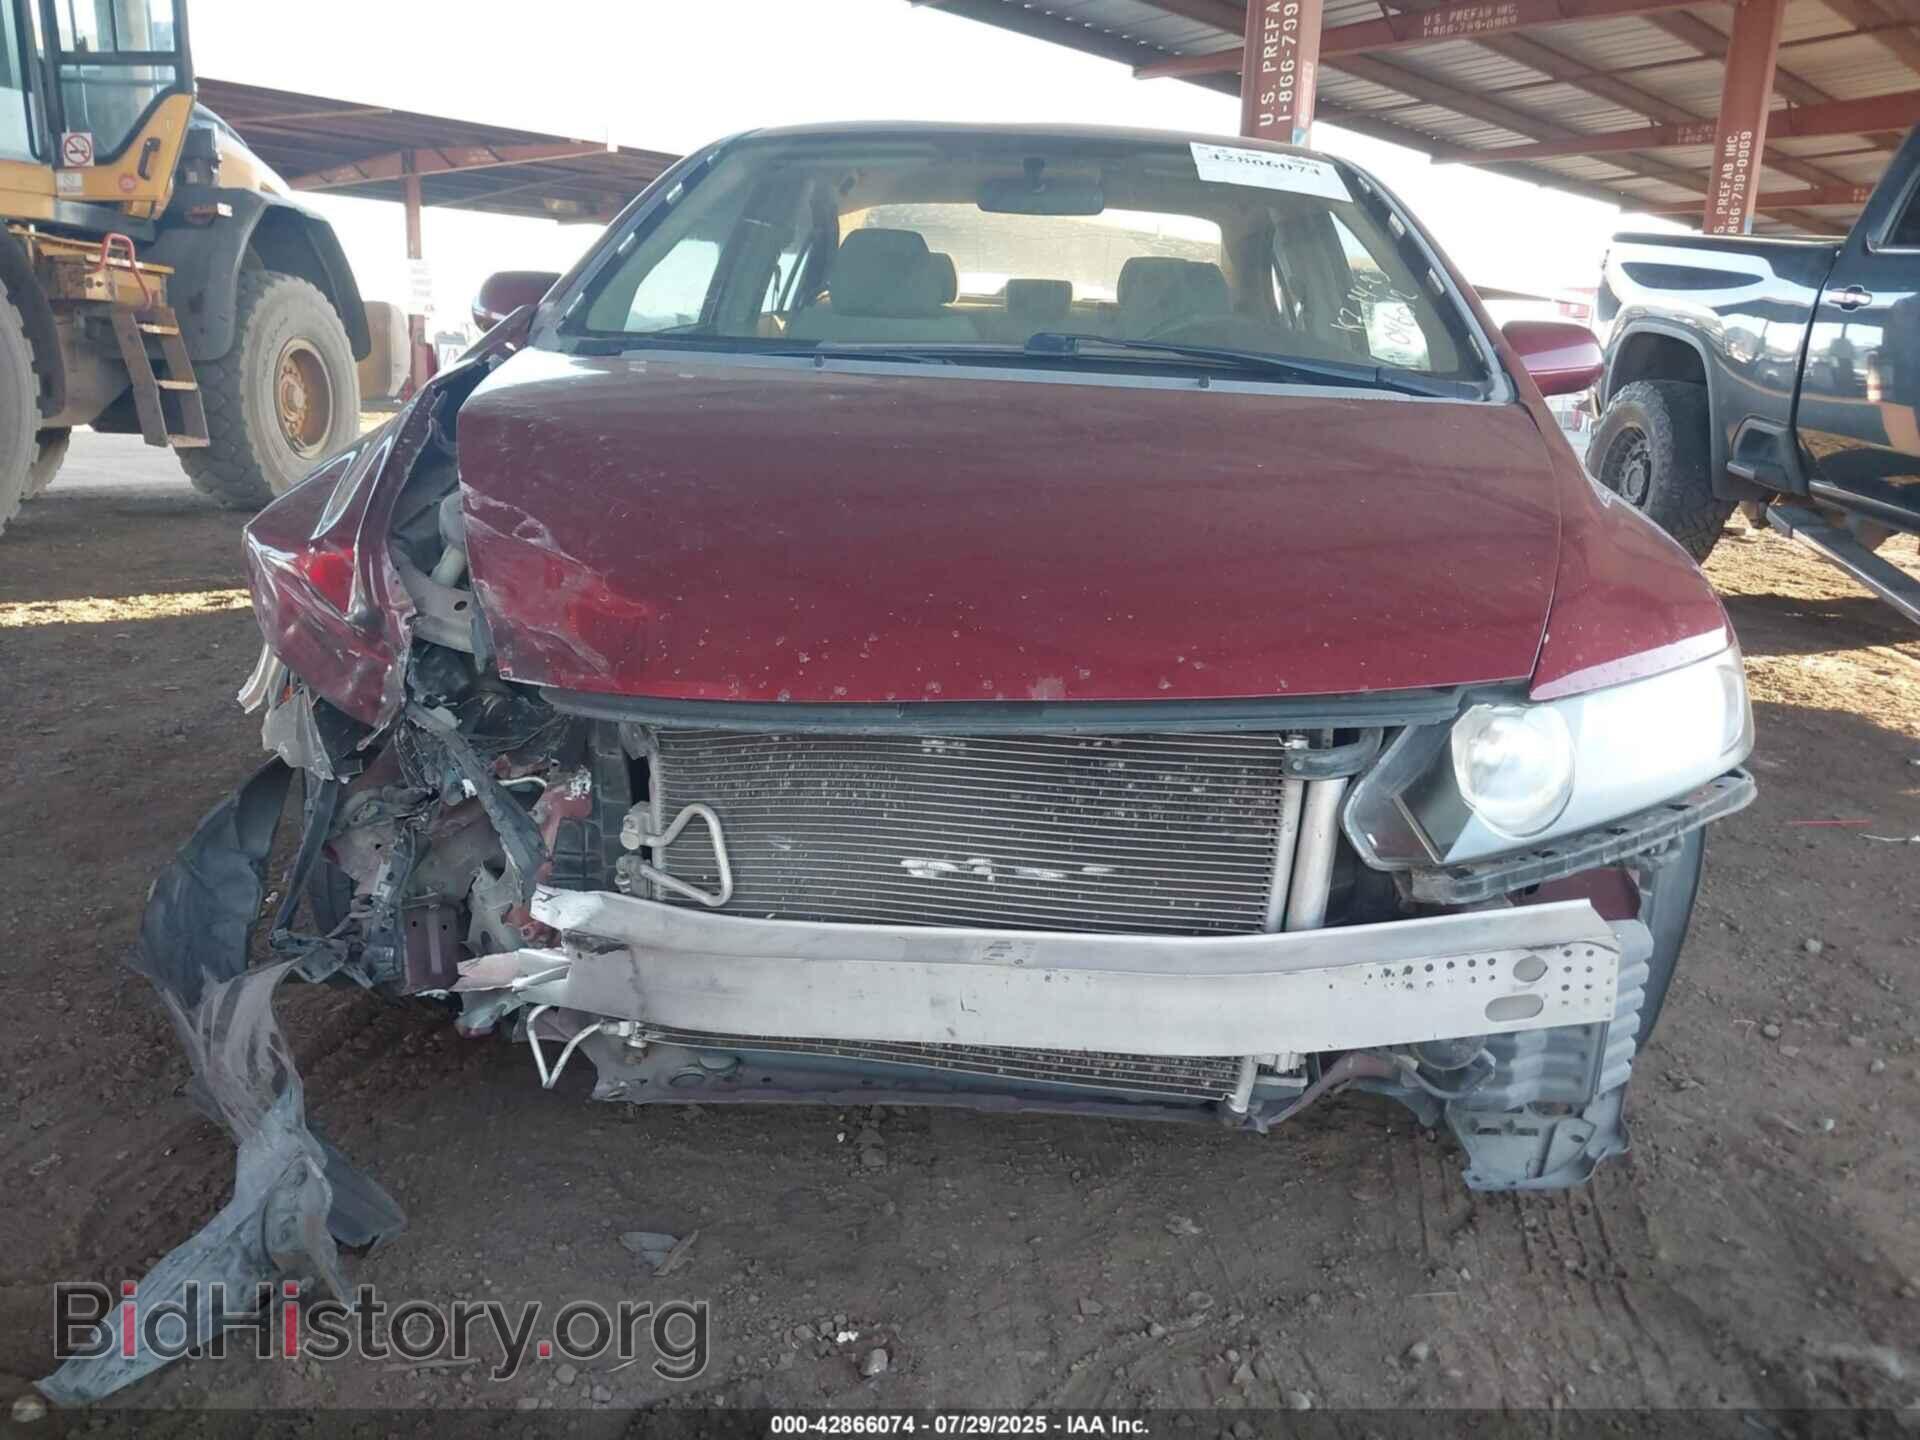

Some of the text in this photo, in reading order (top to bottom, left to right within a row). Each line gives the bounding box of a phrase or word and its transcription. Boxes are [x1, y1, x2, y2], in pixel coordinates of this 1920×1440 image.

[1259, 84, 1277, 127] U.S.
[1716, 163, 1734, 215] PREFAB
[1725, 130, 1740, 157] INC.
